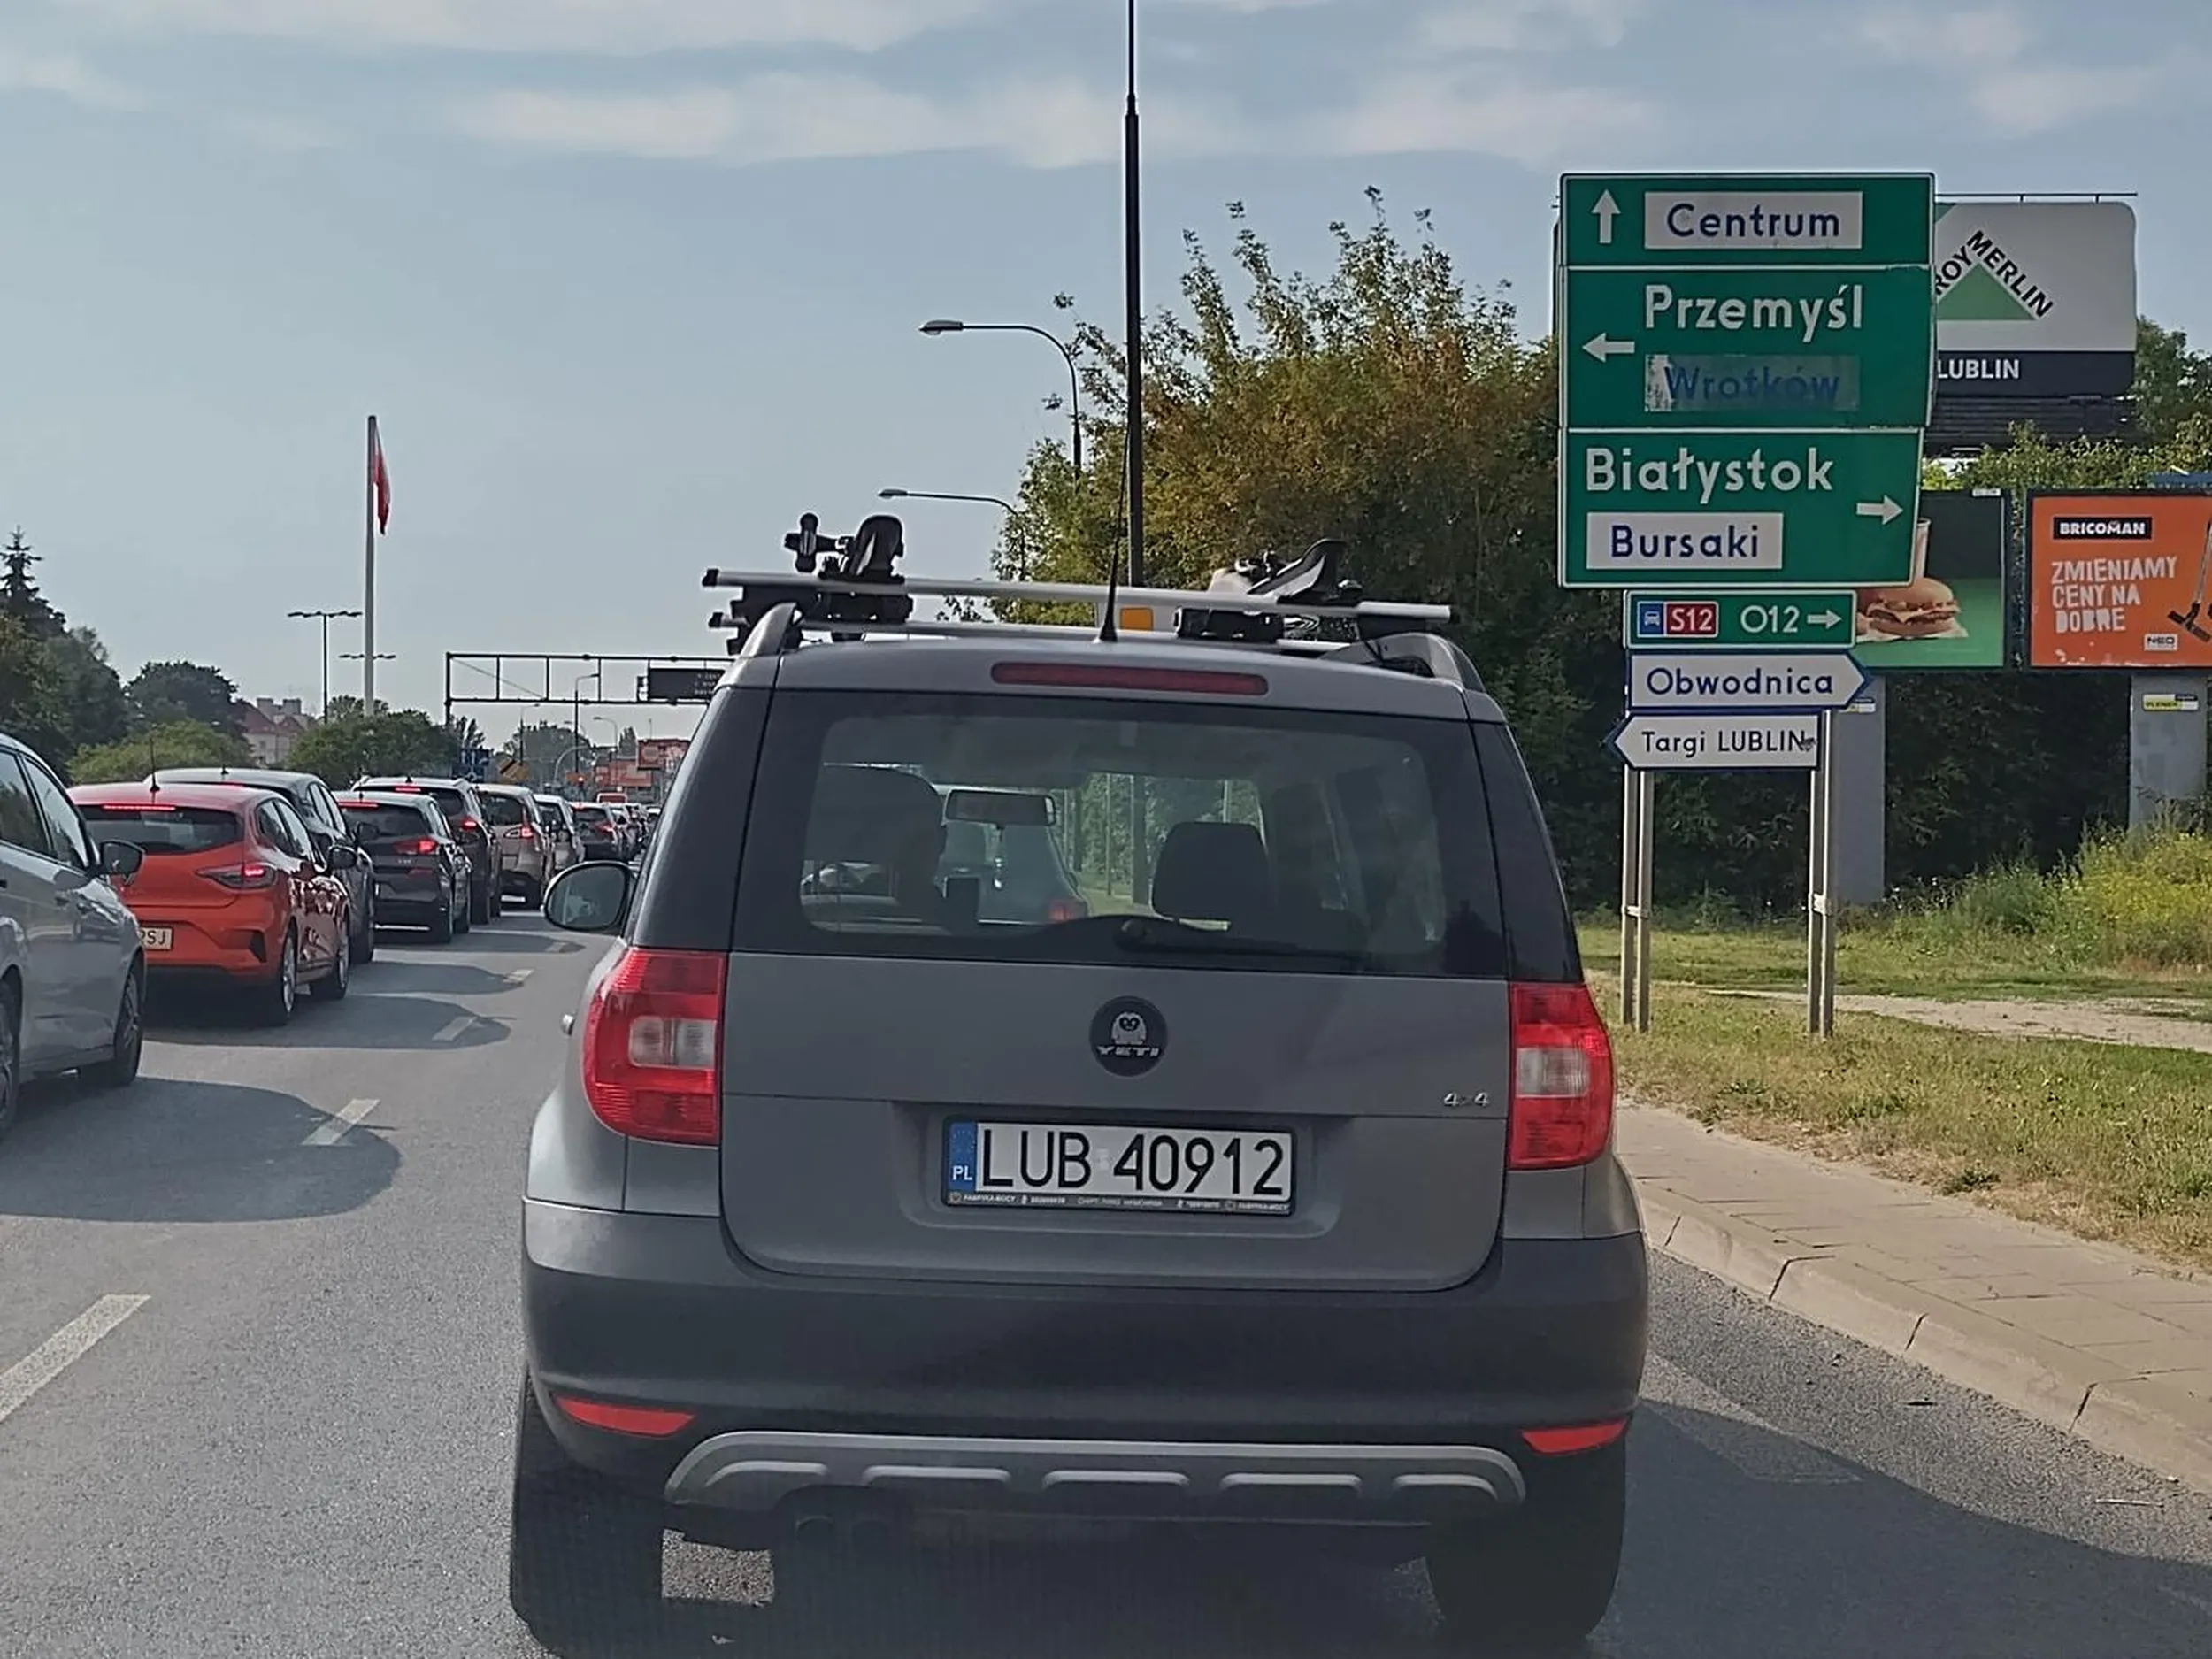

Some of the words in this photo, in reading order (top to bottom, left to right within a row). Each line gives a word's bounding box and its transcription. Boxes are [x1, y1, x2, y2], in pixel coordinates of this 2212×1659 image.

[1666, 203, 1841, 239] Centrum
[1966, 230, 2054, 319] MERLIN
[1645, 284, 1863, 343] Przemyśl
[1938, 358, 2020, 380] LUBLIN
[1663, 365, 1840, 403] Wrotków
[1586, 446, 1834, 505] Białystok
[1610, 524, 1760, 559] Bursaki
[2059, 522, 2146, 535] BRICOMAN
[2051, 555, 2177, 585] ZMIENIAMY
[2052, 584, 2105, 609] CENY
[2112, 583, 2141, 605] NA
[1670, 608, 1713, 632] S12
[2056, 607, 2126, 634] DOBRE
[1647, 667, 1833, 695] Obwodnica
[1641, 731, 1706, 758] Targi
[1717, 730, 1805, 752] LUBLIN
[1097, 1046, 1159, 1056] YETI
[953, 1165, 973, 1180] PL
[983, 1129, 1092, 1188] LUB
[1113, 1133, 1283, 1195] 40912
